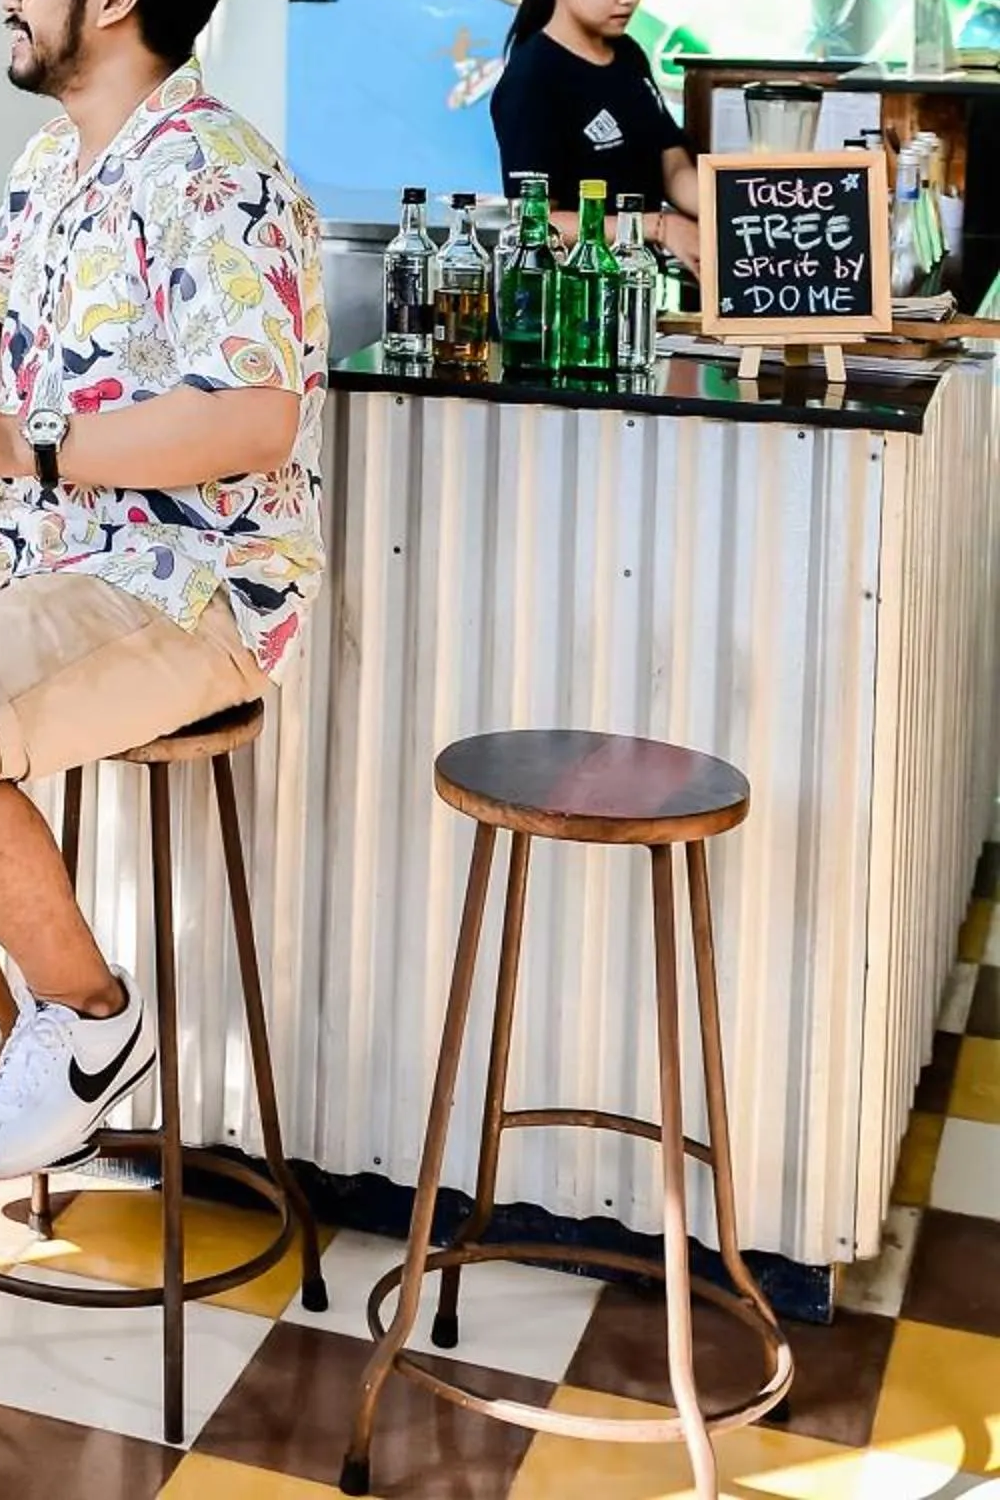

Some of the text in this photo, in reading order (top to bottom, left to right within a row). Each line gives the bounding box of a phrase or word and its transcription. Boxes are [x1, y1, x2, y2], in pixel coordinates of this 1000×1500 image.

[735, 177, 836, 211] Taste
[731, 212, 853, 257] FREE
[743, 285, 855, 314] DOME
